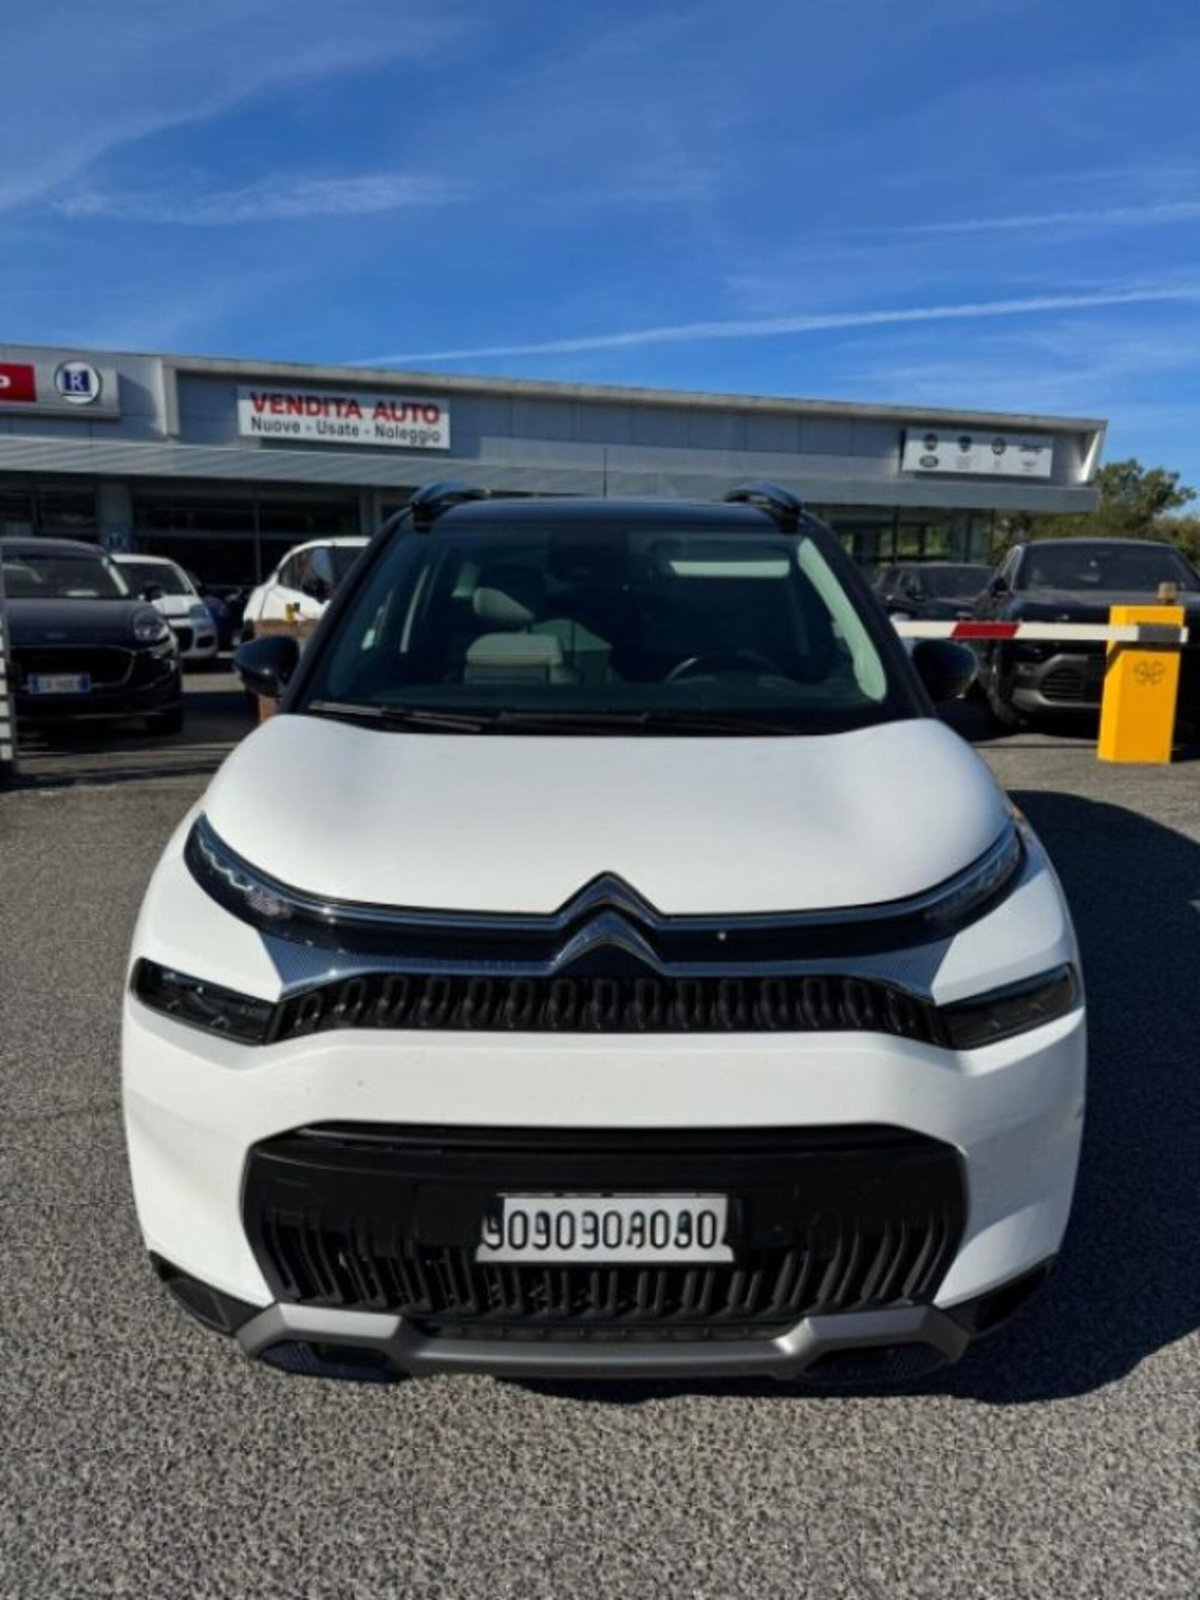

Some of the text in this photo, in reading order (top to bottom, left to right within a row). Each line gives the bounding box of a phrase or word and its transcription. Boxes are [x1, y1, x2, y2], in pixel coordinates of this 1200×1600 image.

[250, 392, 441, 424] VENDITA AUTO
[251, 417, 301, 433] Nuove
[316, 420, 360, 436] Usate
[374, 424, 441, 445] Noleggio
